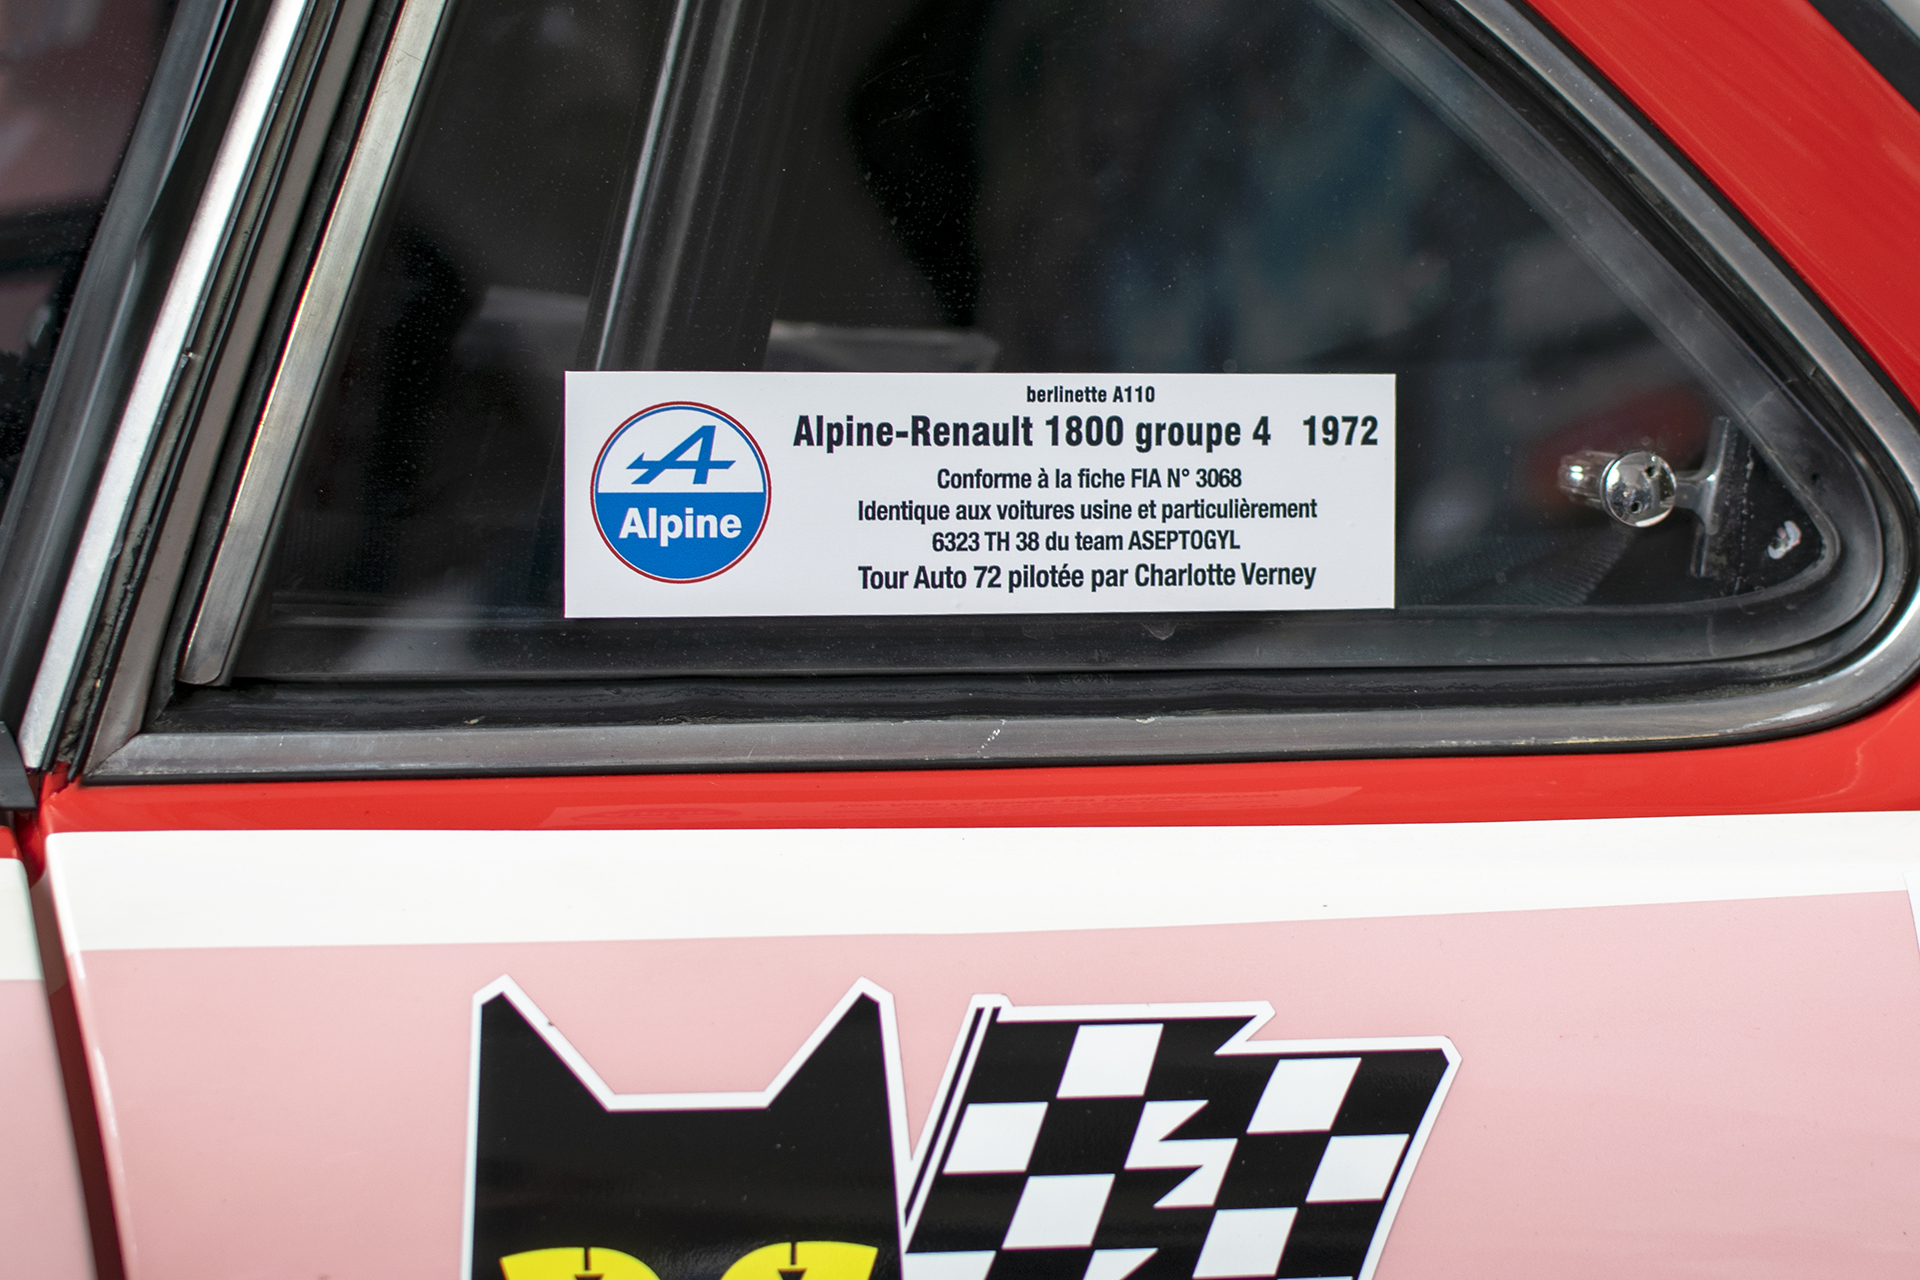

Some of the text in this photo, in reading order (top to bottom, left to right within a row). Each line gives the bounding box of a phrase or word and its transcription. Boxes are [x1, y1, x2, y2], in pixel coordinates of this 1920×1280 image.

[1027, 386, 1154, 402] berlinette A110
[793, 415, 1377, 453] Alpine-Renault 1800 groupe 4 1972
[938, 468, 1242, 489] Conforme à la fiche FIA N° 3068
[859, 498, 1317, 524] Identique aux voitures usine et particulièrement
[619, 508, 741, 546] Alpine
[932, 530, 1240, 552] 6323 TH 38 du team ASEPTOGYL
[858, 563, 1316, 593] Tour Auto 72 pilotée par Charlotte Verney
